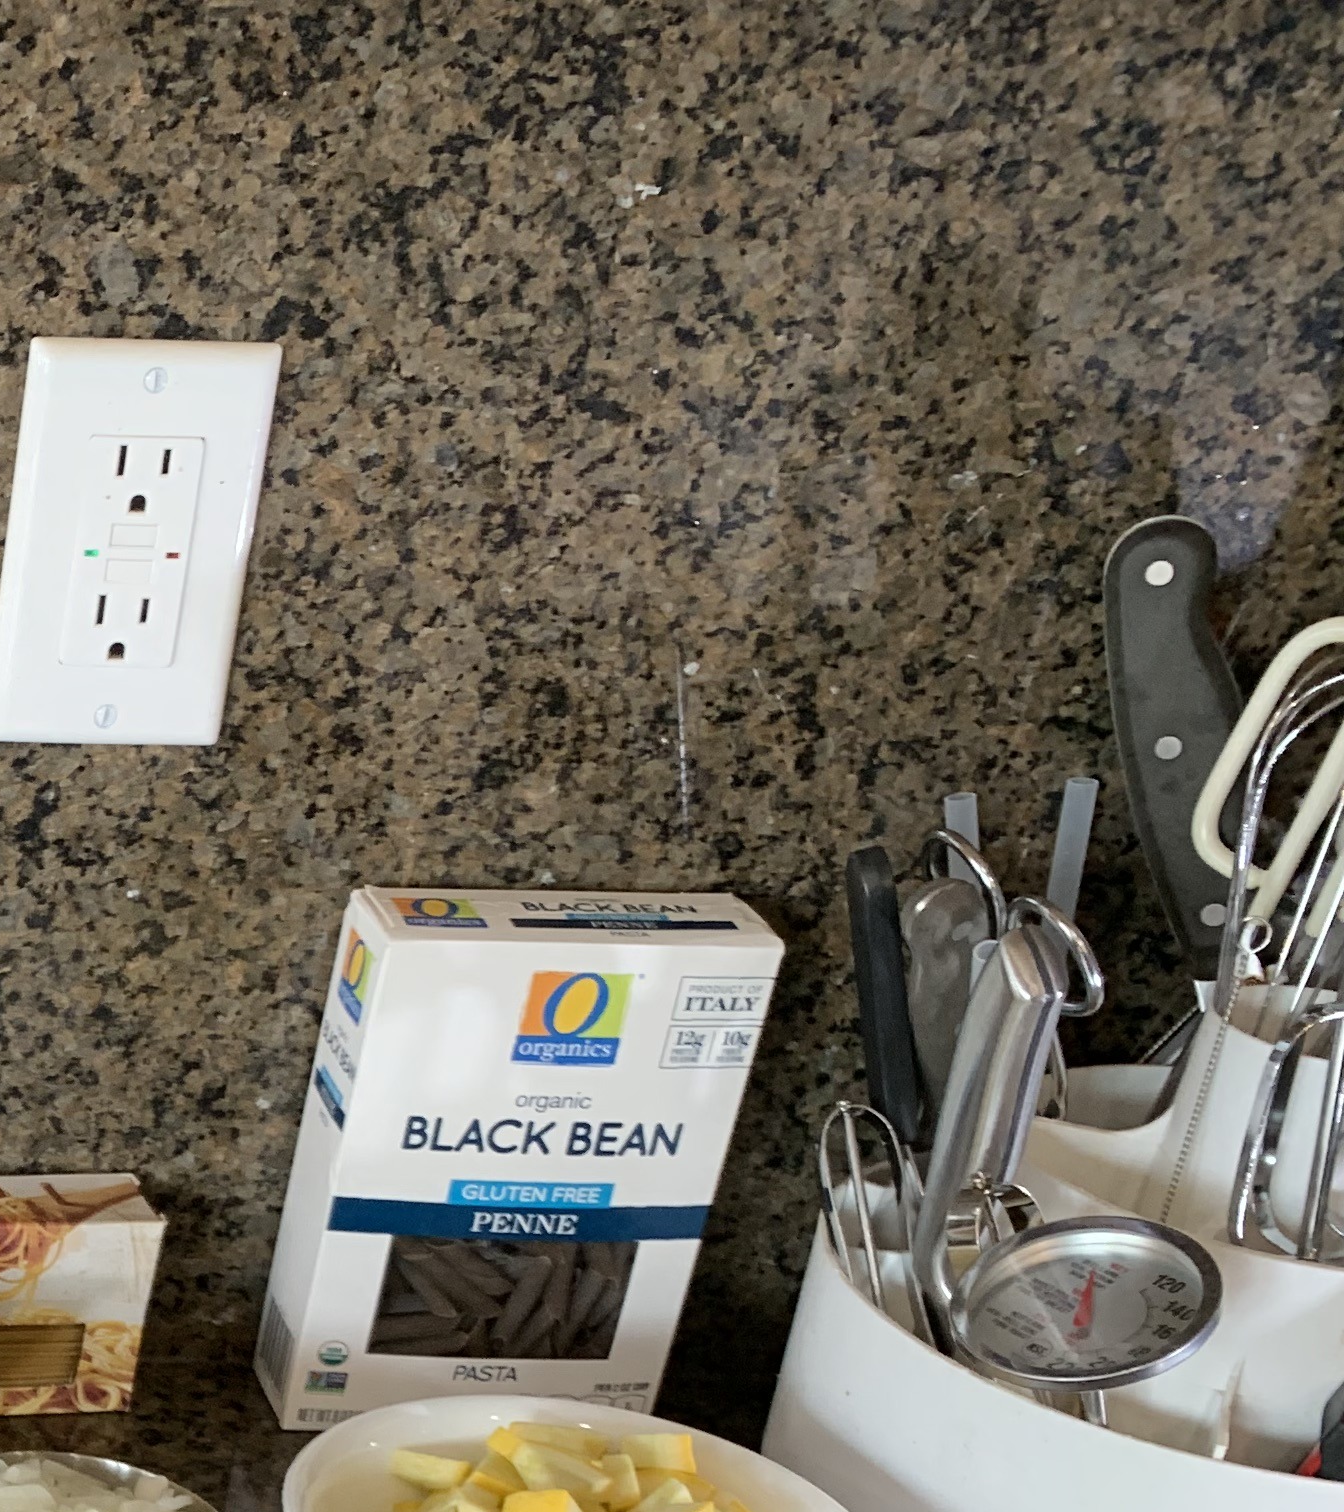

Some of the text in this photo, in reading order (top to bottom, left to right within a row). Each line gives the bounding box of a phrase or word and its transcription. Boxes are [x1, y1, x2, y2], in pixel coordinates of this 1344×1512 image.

[521, 901, 699, 914] BLACK BEAN
[747, 985, 764, 994] OF
[683, 996, 762, 1011] ITALY
[518, 1039, 612, 1062] organics
[515, 1092, 592, 1113] organic
[401, 1116, 684, 1157] BLACK BEAN
[461, 1184, 602, 1204] GLUTEN FREE
[470, 1212, 579, 1235] PENNE
[1152, 1274, 1186, 1293] 120
[1165, 1301, 1196, 1320] 140
[452, 1365, 518, 1382] PASTA
